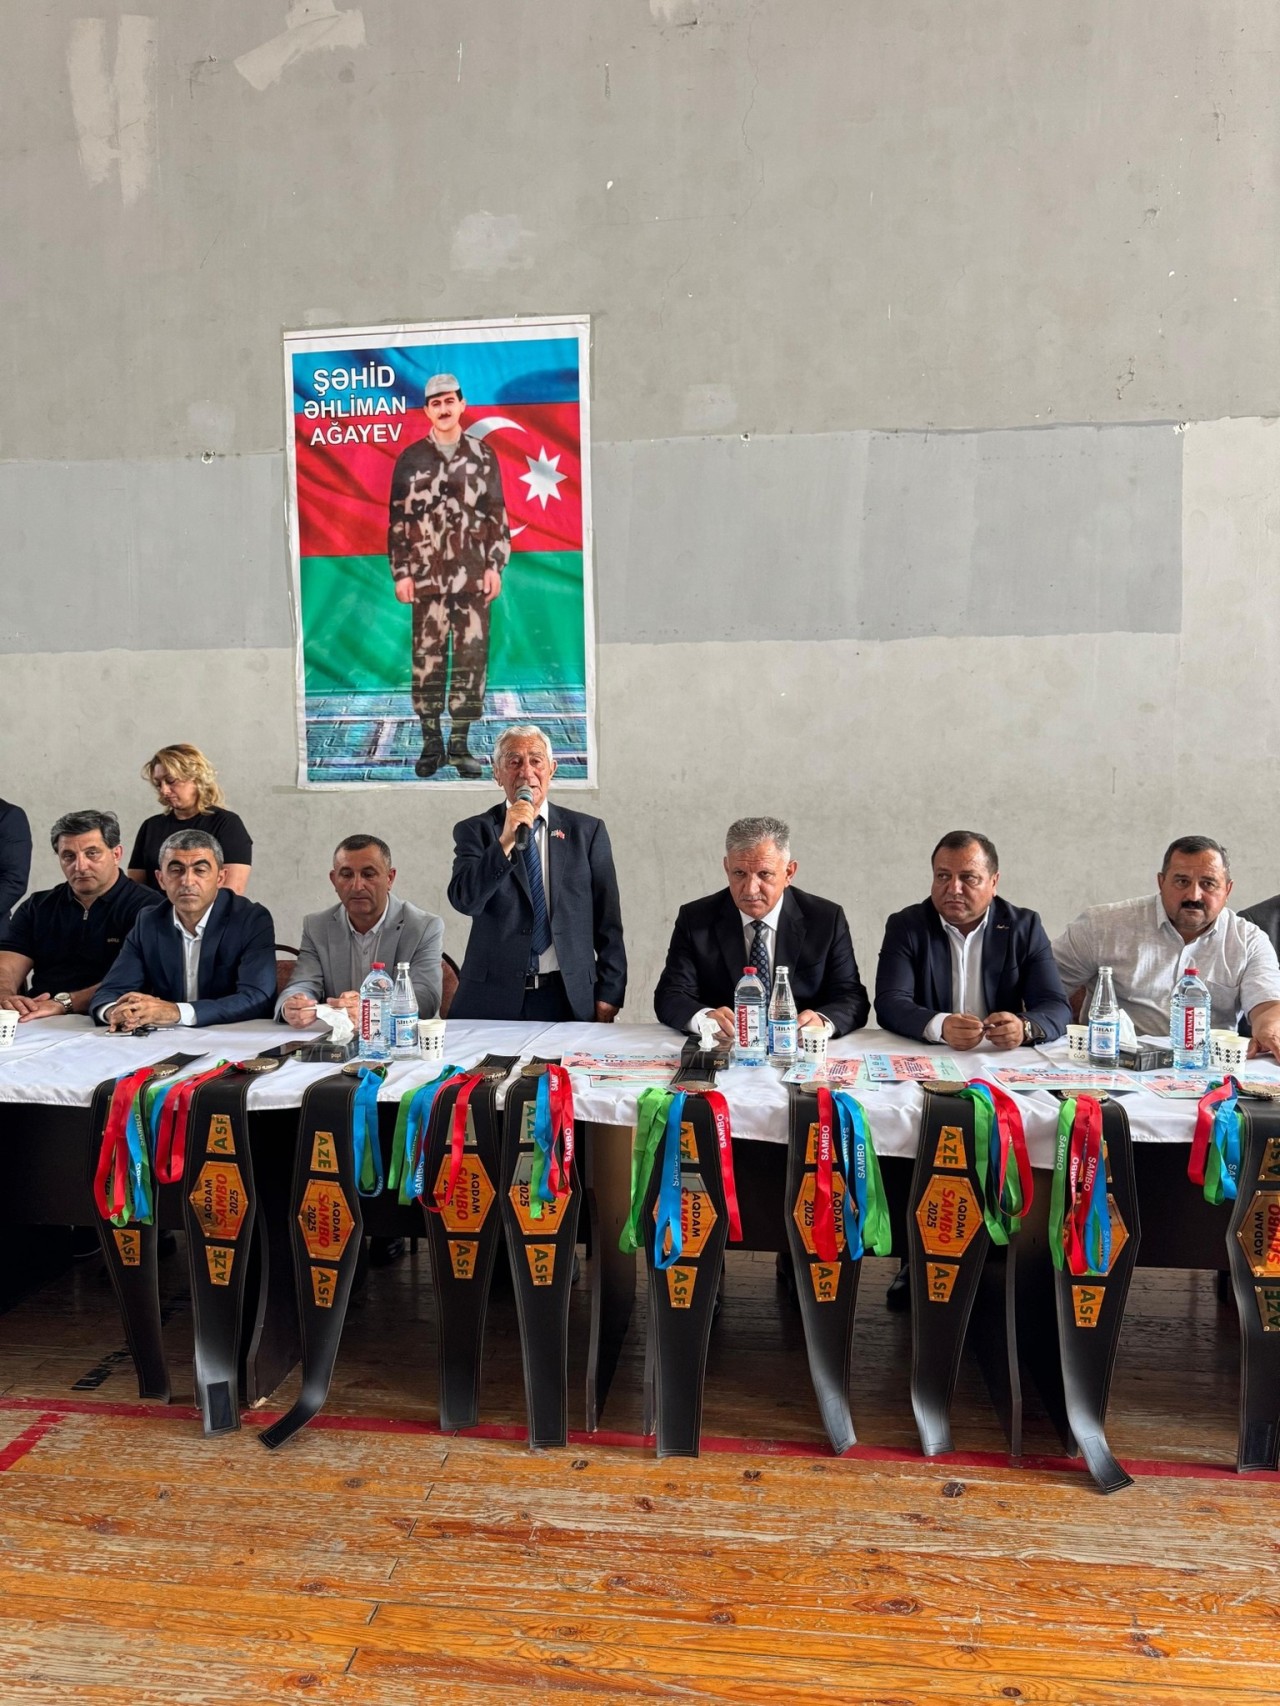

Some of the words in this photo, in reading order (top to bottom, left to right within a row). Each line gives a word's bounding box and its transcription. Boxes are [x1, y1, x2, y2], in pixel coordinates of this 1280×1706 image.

[313, 361, 395, 396] ŞƏHİD
[304, 394, 406, 419] ƏHLİMAN
[310, 421, 402, 446] AĞAYEV
[214, 1117, 227, 1150] ASF
[564, 1127, 572, 1162] SAMBO
[716, 1113, 727, 1149] SAMBO
[821, 1125, 830, 1161] SAMBO
[943, 1130, 958, 1165] AZE
[317, 1135, 331, 1169] AZE
[857, 1143, 865, 1179] SAMBO
[1056, 1134, 1067, 1171] SAMBO
[1084, 1156, 1097, 1192] SAMBO
[204, 1179, 213, 1220] AQDAM
[215, 1173, 228, 1228] SAMBO
[229, 1189, 239, 1216] 2025
[471, 1172, 480, 1214] AQDAM
[519, 1179, 530, 1207] 2025
[307, 1205, 317, 1232] 2025
[318, 1192, 330, 1248] SAMBO
[332, 1201, 341, 1243] AQDAM
[692, 1193, 701, 1238] AQDAM
[804, 1199, 814, 1228] 2025
[832, 1190, 842, 1233] AQDAM
[926, 1200, 938, 1229] 2025
[938, 1187, 956, 1245] SAMBO
[955, 1196, 968, 1239] AQDAM
[121, 1232, 136, 1263] ASF
[1254, 1211, 1264, 1257] AQDAM
[213, 1250, 227, 1281] AZE
[456, 1244, 470, 1276] ASF
[534, 1248, 548, 1283] ASF
[318, 1271, 331, 1305] ASF
[674, 1269, 689, 1306] ASF
[818, 1266, 833, 1299] ASF
[933, 1266, 950, 1300] ASF
[1080, 1289, 1096, 1324] ASF
